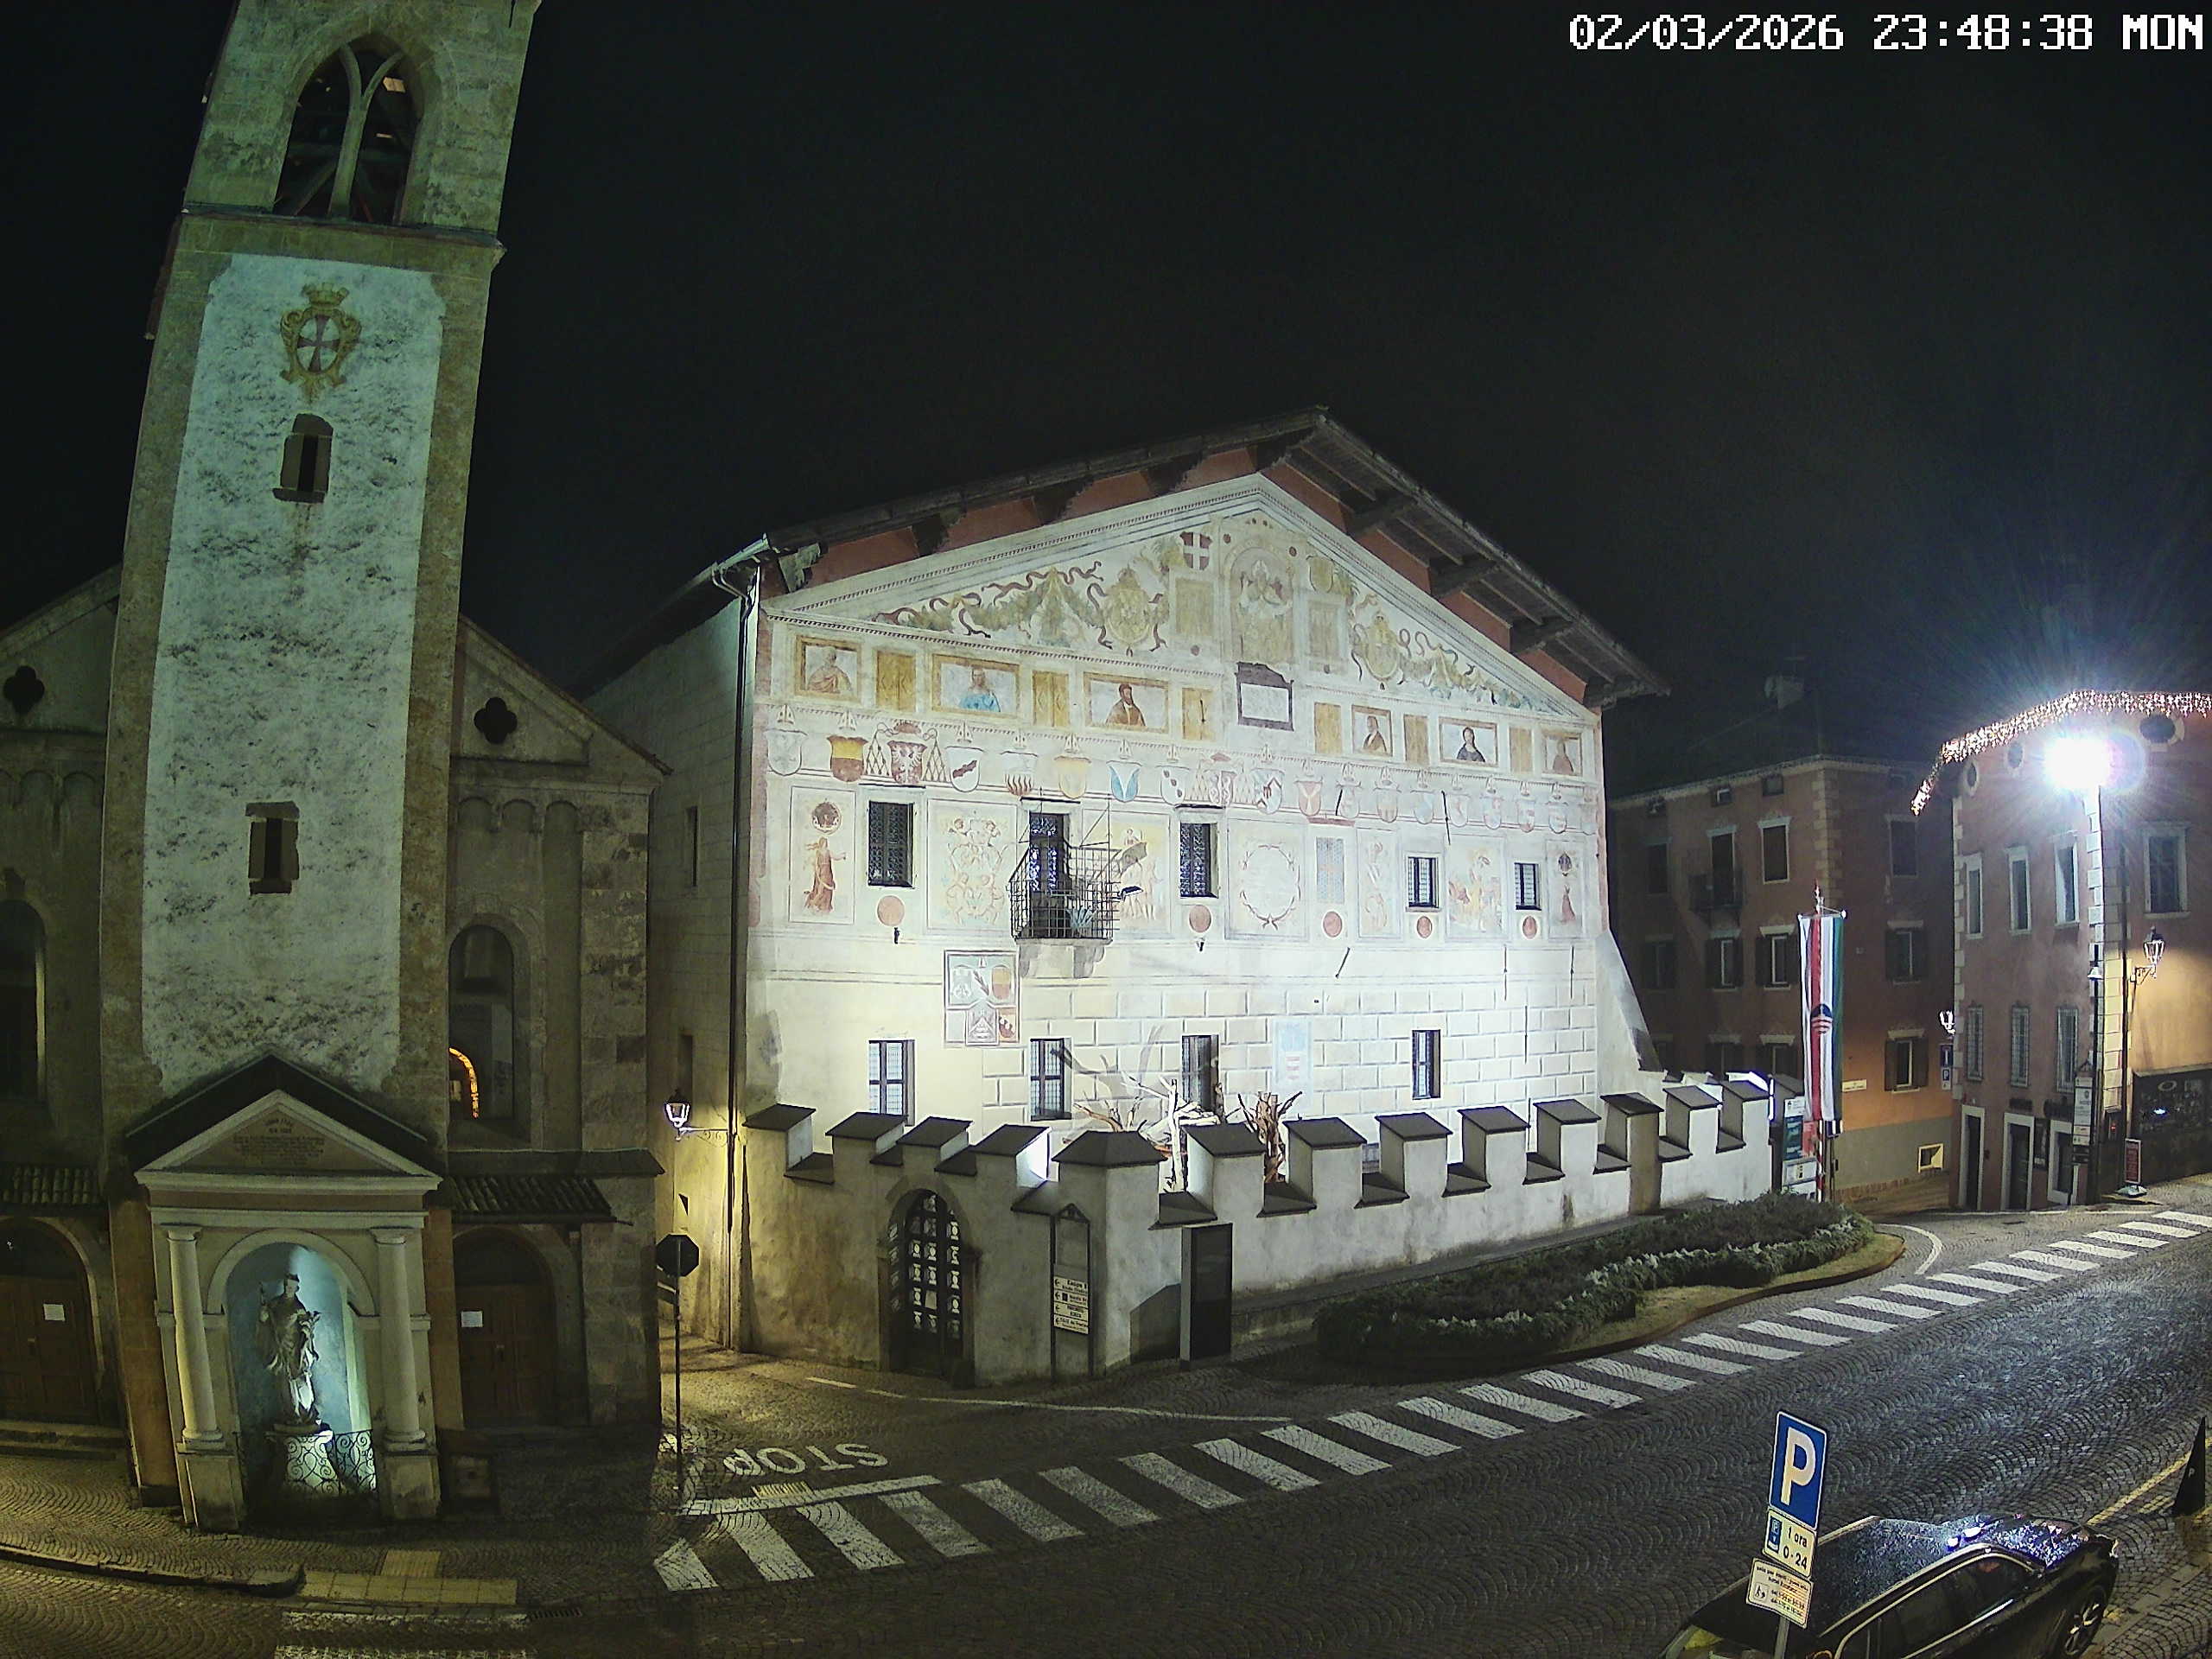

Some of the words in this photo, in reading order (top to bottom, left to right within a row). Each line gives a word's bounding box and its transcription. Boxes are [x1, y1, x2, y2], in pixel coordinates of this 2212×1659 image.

[723, 1443, 888, 1476] STOP
[1781, 1426, 1815, 1505] P
[1788, 1526, 1792, 1540] 1
[1794, 1533, 1808, 1548] ora
